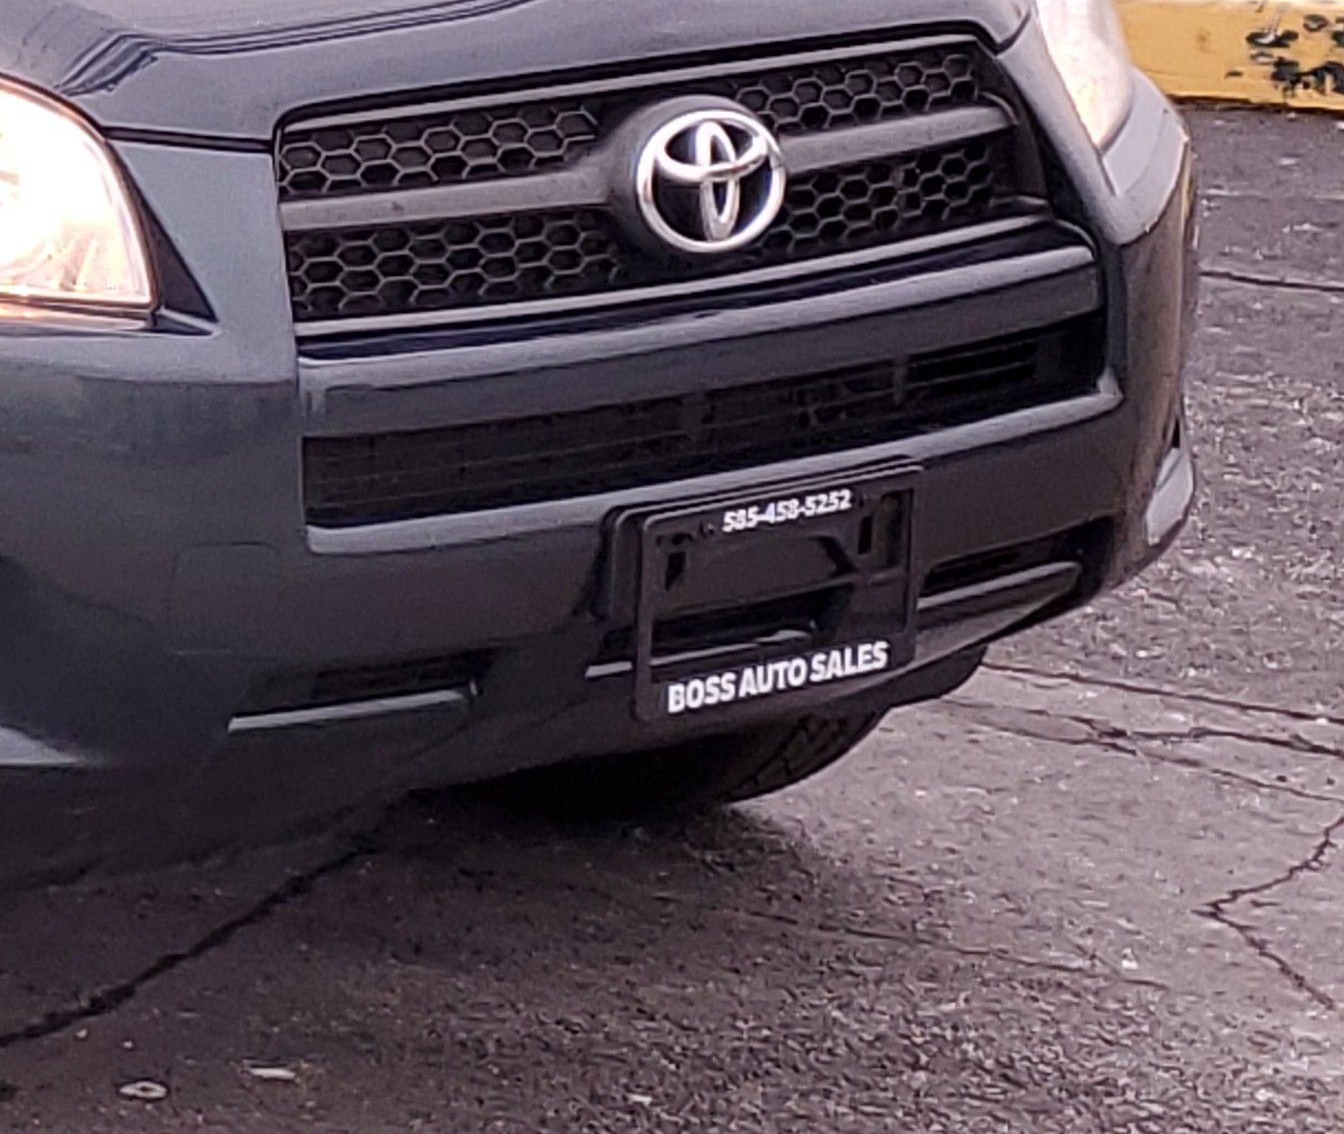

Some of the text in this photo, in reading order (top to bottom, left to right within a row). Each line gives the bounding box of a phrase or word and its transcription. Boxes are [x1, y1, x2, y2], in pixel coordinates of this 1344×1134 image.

[721, 489, 853, 533] 585-458-5252
[667, 640, 890, 714] BOSS AUTO SALES
